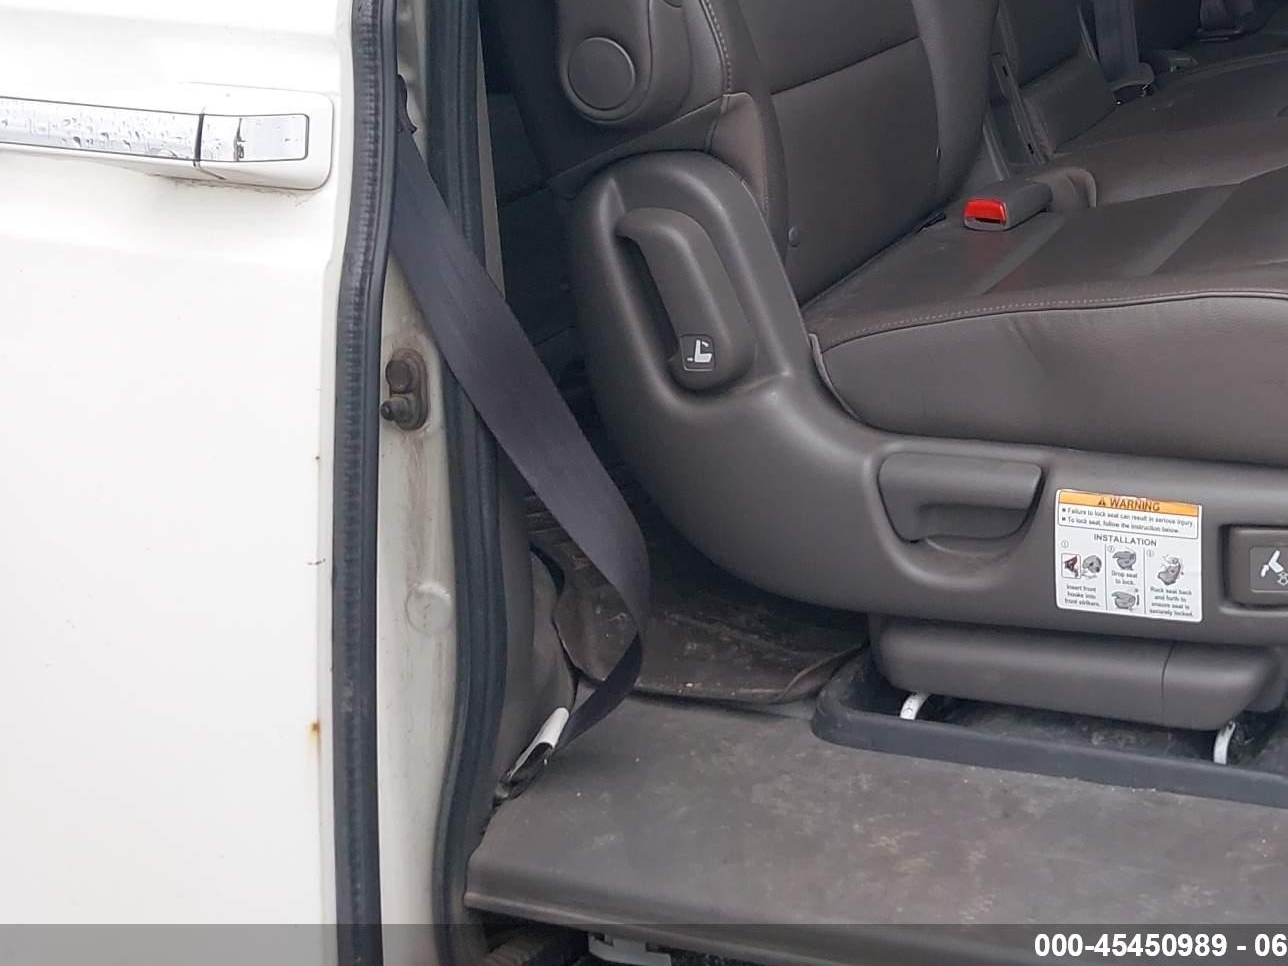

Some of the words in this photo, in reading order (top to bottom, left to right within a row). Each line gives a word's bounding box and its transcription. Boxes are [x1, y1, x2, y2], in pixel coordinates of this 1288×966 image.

[1110, 496, 1161, 511] WARNING
[1067, 507, 1087, 515] Failure
[1094, 509, 1106, 517] lock
[1131, 514, 1148, 522] result
[1093, 533, 1157, 547] INSTALLATION
